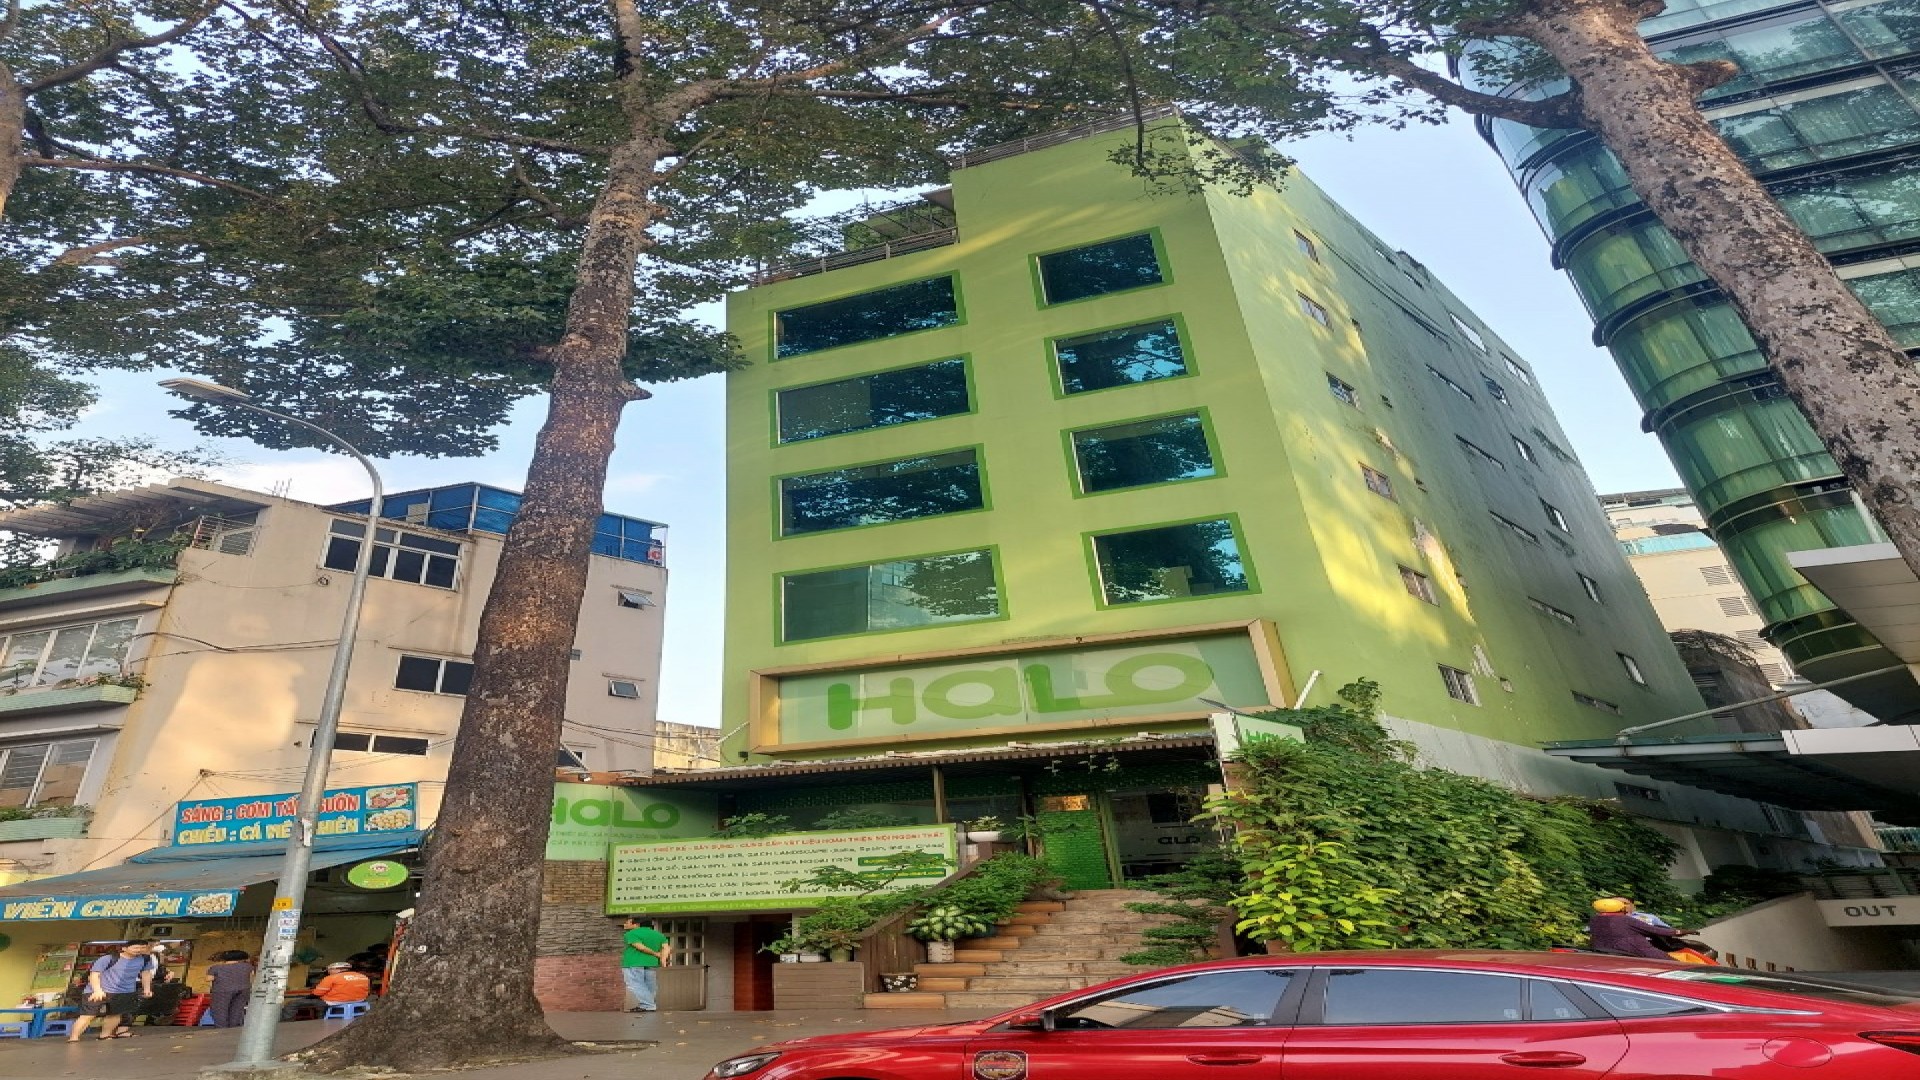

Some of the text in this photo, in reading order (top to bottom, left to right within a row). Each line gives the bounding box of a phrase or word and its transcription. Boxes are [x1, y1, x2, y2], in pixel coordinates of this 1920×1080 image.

[181, 803, 224, 823] SÁNG
[239, 821, 262, 841] CÁ
[316, 815, 359, 835] HIÊN
[1844, 905, 1897, 917] OUT
